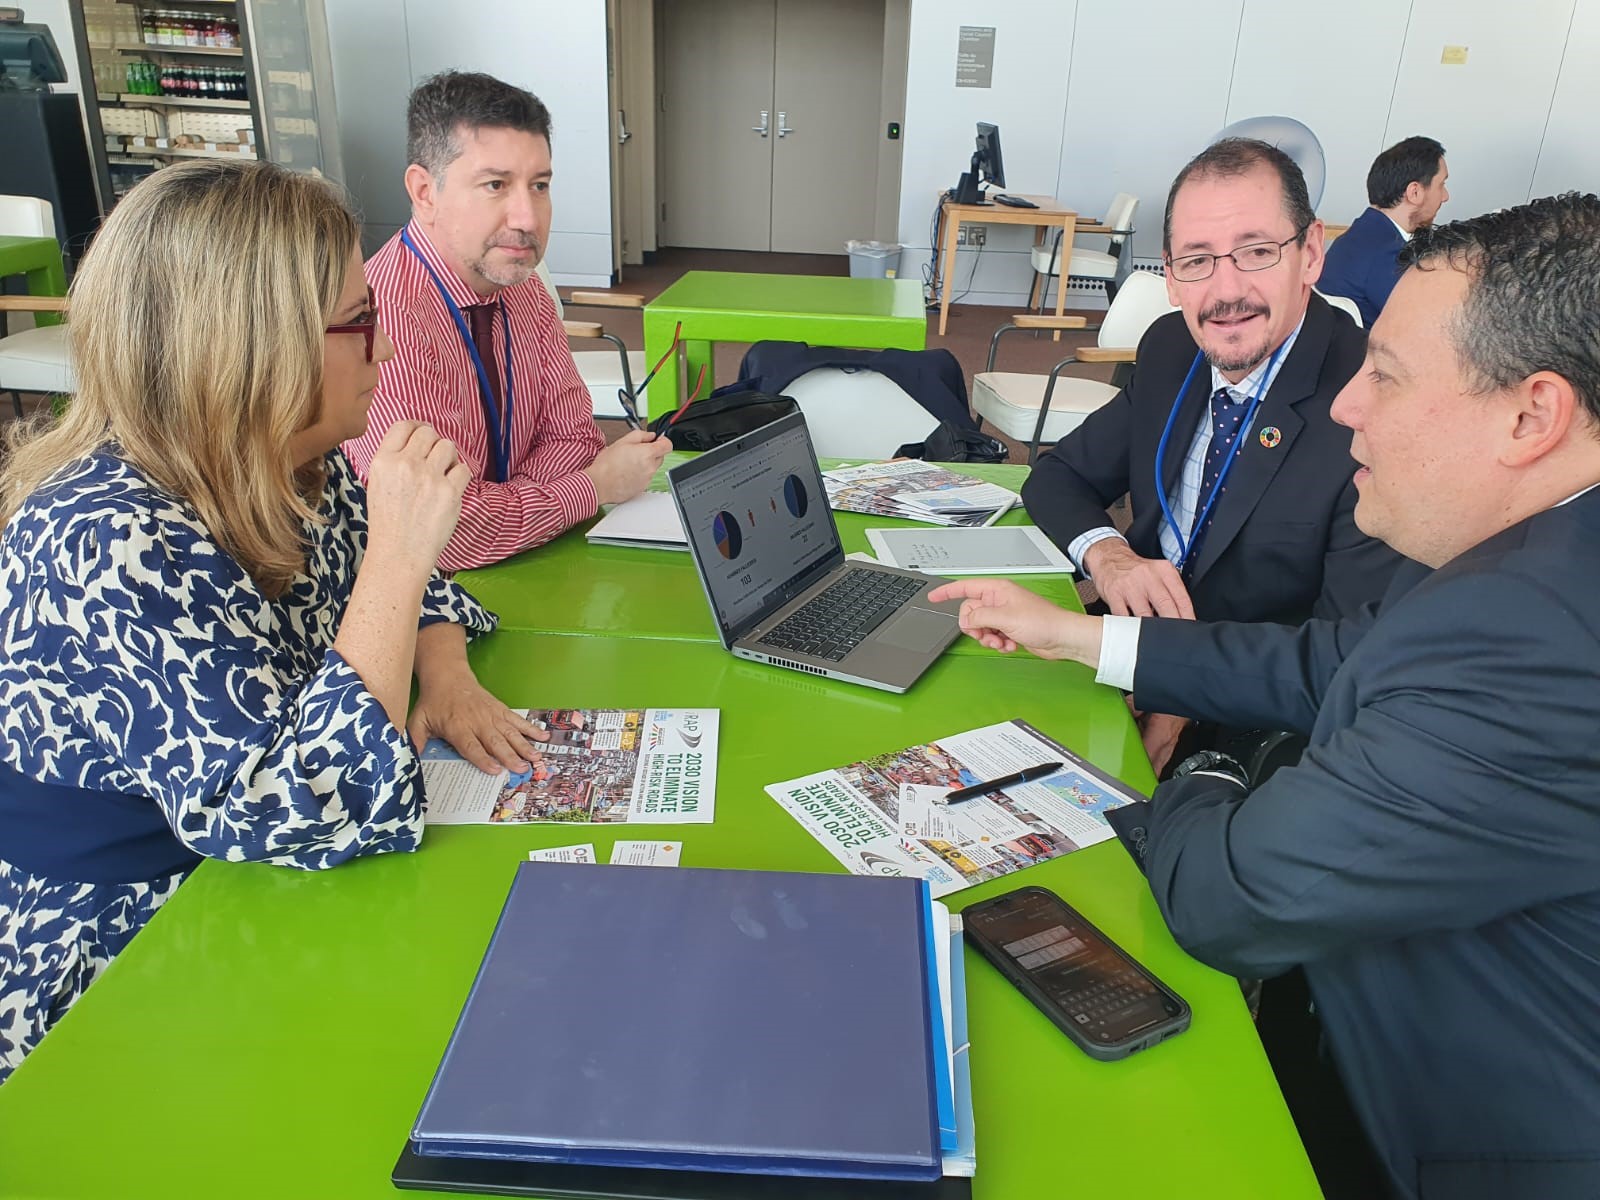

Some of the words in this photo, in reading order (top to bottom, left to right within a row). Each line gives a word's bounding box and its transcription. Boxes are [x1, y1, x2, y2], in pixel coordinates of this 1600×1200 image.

[740, 574, 752, 585] 103
[649, 754, 664, 787] HIGH-RISK
[668, 753, 682, 764] TO
[685, 753, 702, 777] 2030
[645, 790, 660, 813] ROADS
[661, 767, 681, 813] ELIMINATE
[681, 780, 699, 812] VISION
[788, 788, 829, 821] VISION
[820, 780, 851, 802] ROADS
[804, 784, 862, 830] ELIMINATE
[844, 801, 891, 838] HIGH-RISK
[824, 820, 860, 849] 2030
[856, 829, 876, 844] TO
